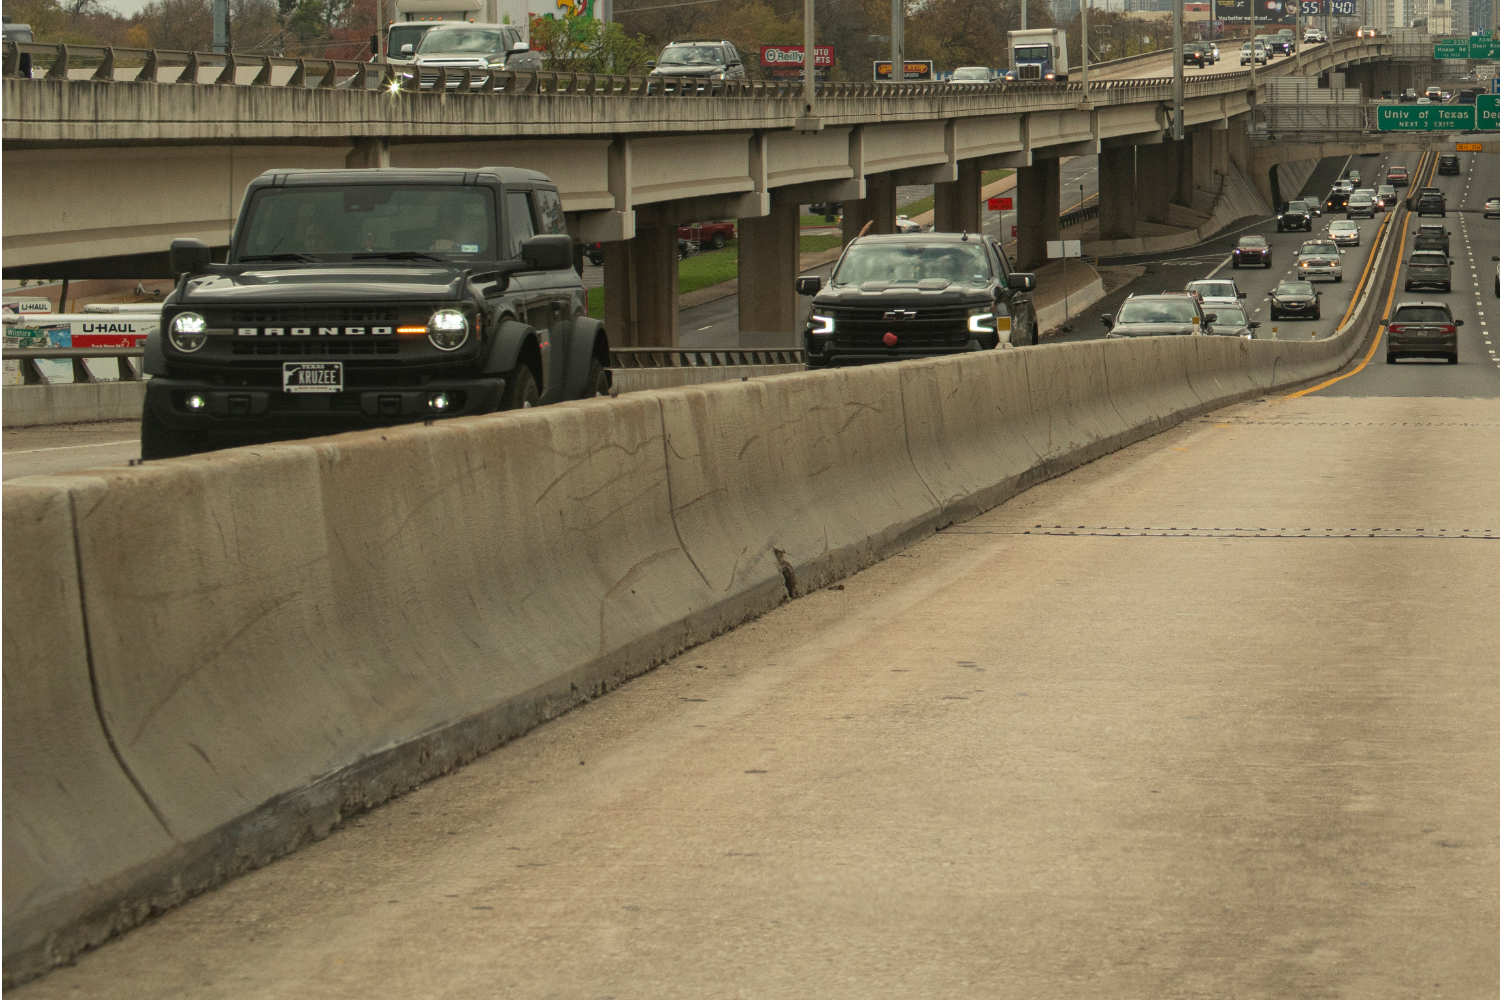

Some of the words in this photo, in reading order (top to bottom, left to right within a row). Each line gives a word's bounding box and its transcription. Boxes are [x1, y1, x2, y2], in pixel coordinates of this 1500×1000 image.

[1384, 110, 1410, 119] Univ
[1418, 110, 1429, 119] of
[1438, 110, 1469, 119] Texas
[21, 303, 48, 311] U-HAUL
[82, 323, 136, 333] U-HAUL
[237, 326, 393, 336] BRONCO
[8, 329, 32, 337] Wilshire
[298, 370, 337, 384] KRUZEE
